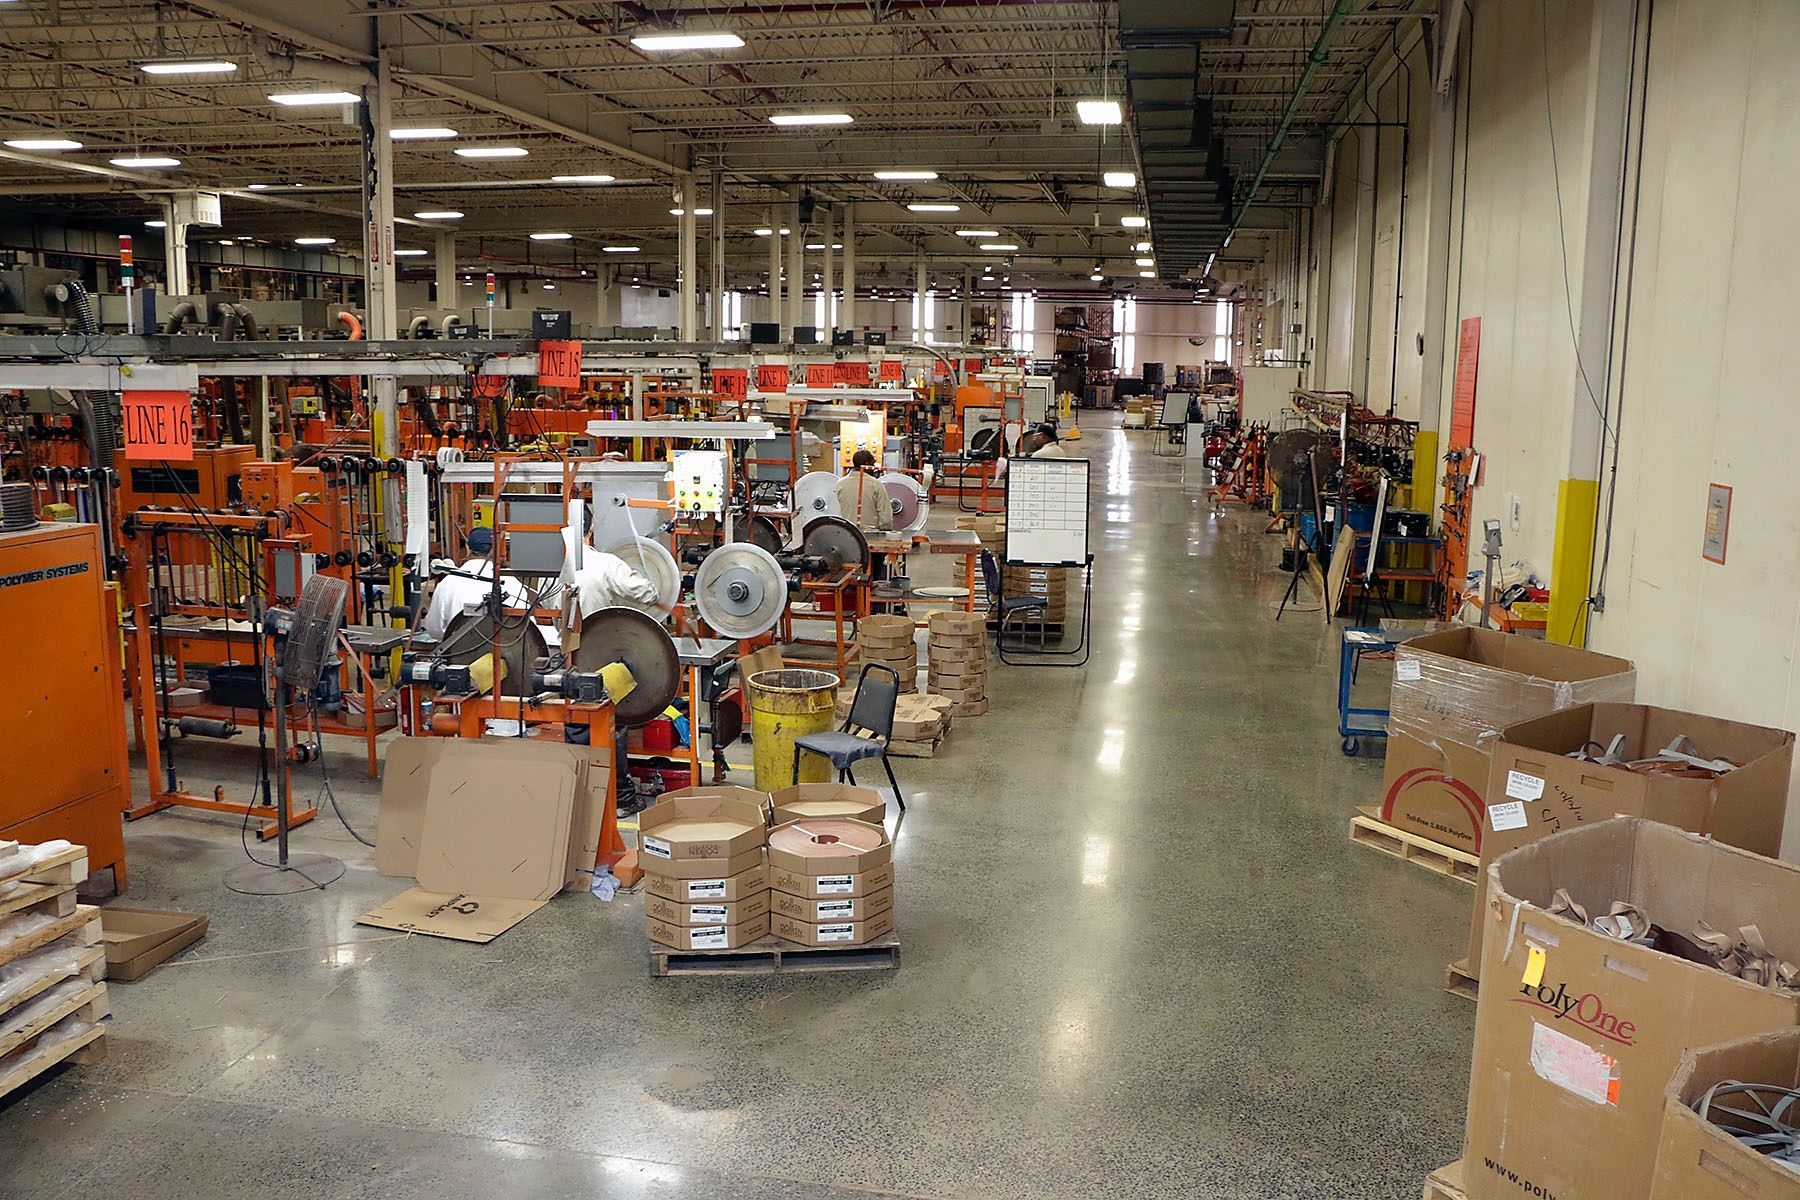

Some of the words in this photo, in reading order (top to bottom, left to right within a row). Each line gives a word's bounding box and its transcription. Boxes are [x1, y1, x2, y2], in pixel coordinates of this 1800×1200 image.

[540, 350, 565, 376] LINE
[569, 352, 579, 377] 15
[713, 375, 735, 393] LINE
[758, 371, 777, 387] LINE
[780, 371, 787, 387] 12
[808, 369, 824, 384] LINE
[827, 369, 833, 383] 11
[125, 405, 167, 445] LINE
[172, 404, 189, 446] 16
[0, 571, 43, 588] POLYMER
[46, 562, 88, 579] SYSTEMS
[1512, 772, 1540, 785] RECYCLE
[1492, 803, 1519, 813] RECYCLE
